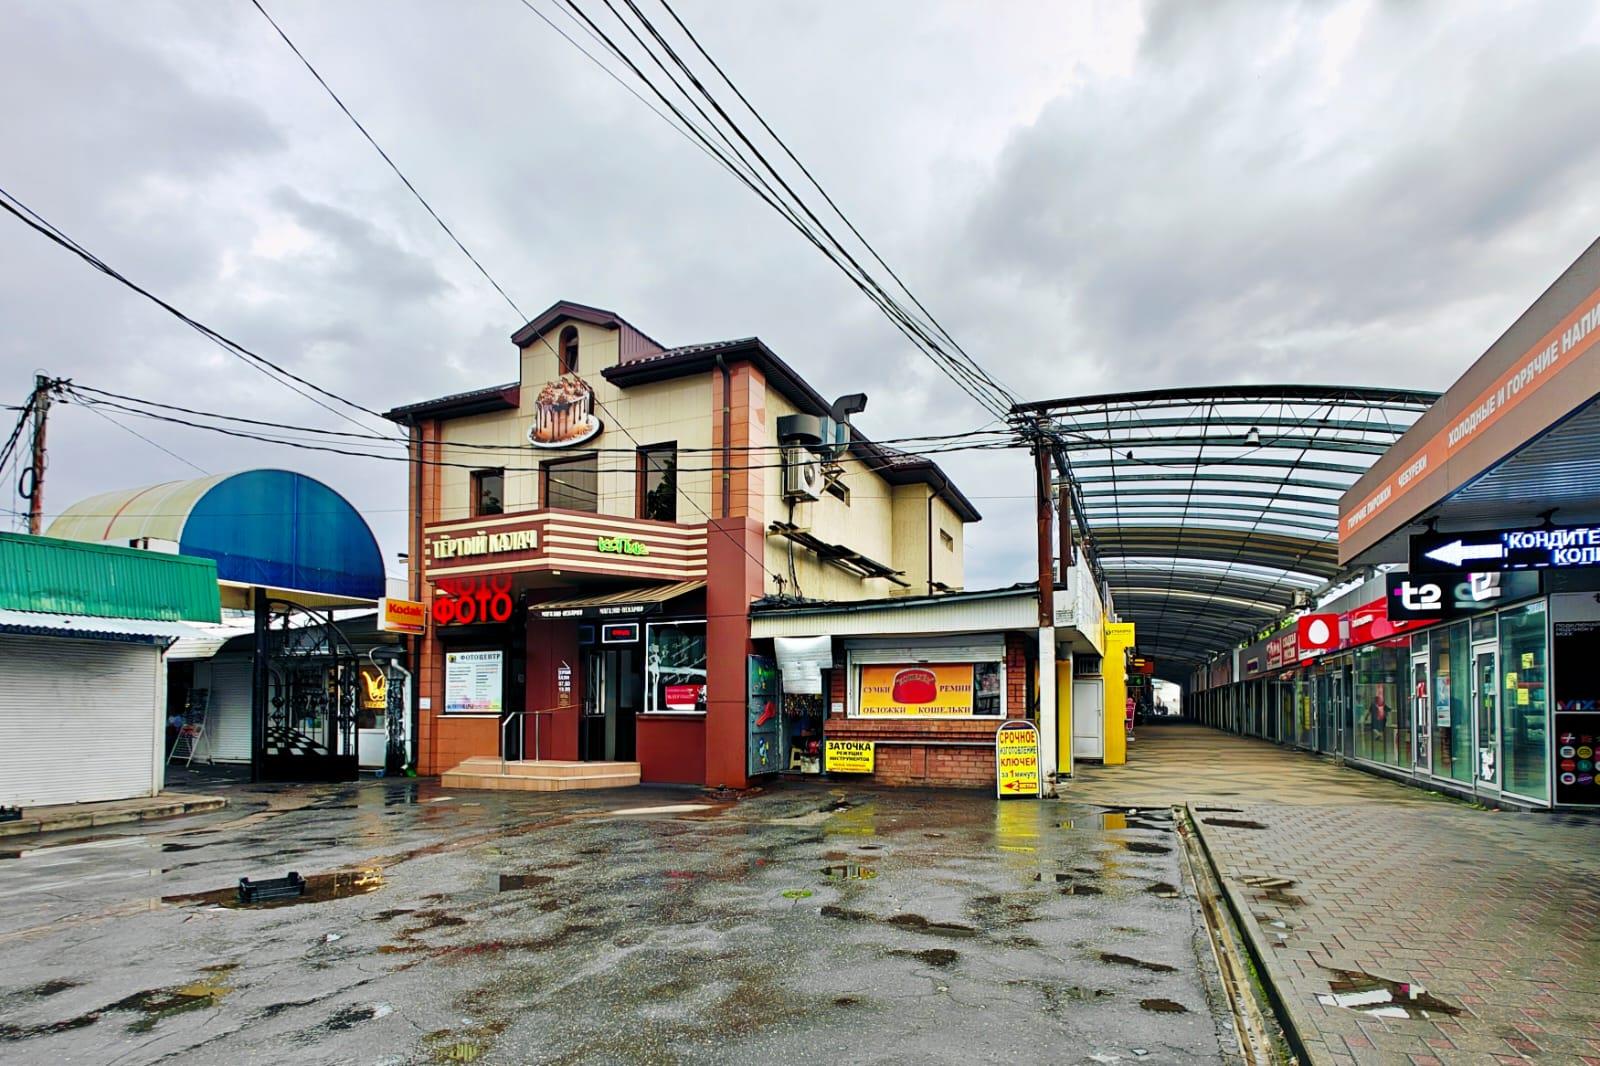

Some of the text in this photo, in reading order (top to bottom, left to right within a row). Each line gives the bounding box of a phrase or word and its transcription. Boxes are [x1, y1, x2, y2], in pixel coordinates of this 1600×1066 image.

[1448, 395, 1496, 448] ХОЛОДНЫЕ
[1497, 388, 1505, 407] И
[1507, 340, 1559, 399] ГОРЯЧИЕ
[1398, 454, 1428, 488] ЧЕБУРЕКИ
[432, 530, 538, 559] ТЁРТЫЙ КАЛАЧ
[1554, 547, 1600, 563] КОП
[1395, 581, 1442, 610] t2
[388, 602, 424, 617] Kodak
[433, 592, 513, 625] ФОТО
[460, 653, 501, 661] ФОТОЦЕНТР
[863, 685, 890, 694] СУМКИ
[939, 685, 971, 693] РЕМНИ
[863, 706, 971, 715] ОБЛОЖКИ КОШЕЛЬКИ
[999, 731, 1036, 744] СРОЧНОЕ
[828, 742, 871, 751] ЗАТОЧКА
[1000, 756, 1037, 767] КЛЮЧЕЙ
[1009, 769, 1014, 778] 1
